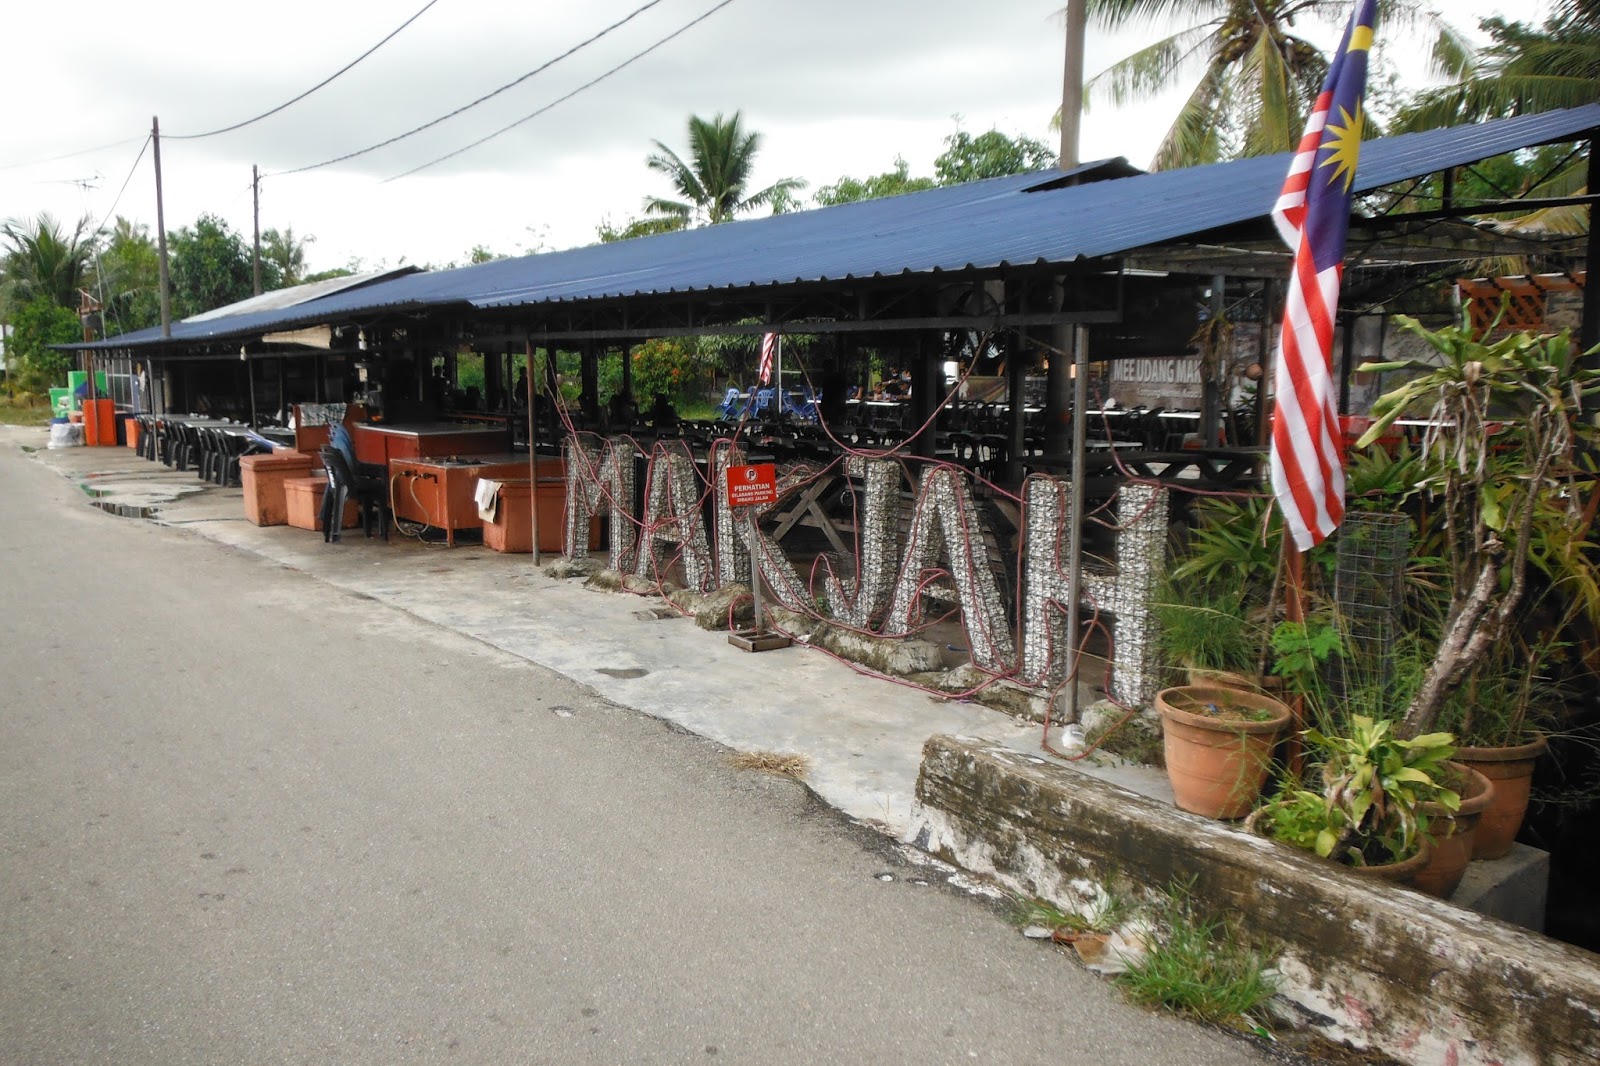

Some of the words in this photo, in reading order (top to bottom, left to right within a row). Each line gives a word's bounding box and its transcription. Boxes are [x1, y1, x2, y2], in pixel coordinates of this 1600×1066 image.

[1113, 359, 1135, 381] MEE
[1136, 359, 1174, 382] UDANG
[734, 483, 770, 492] PERHATIAN
